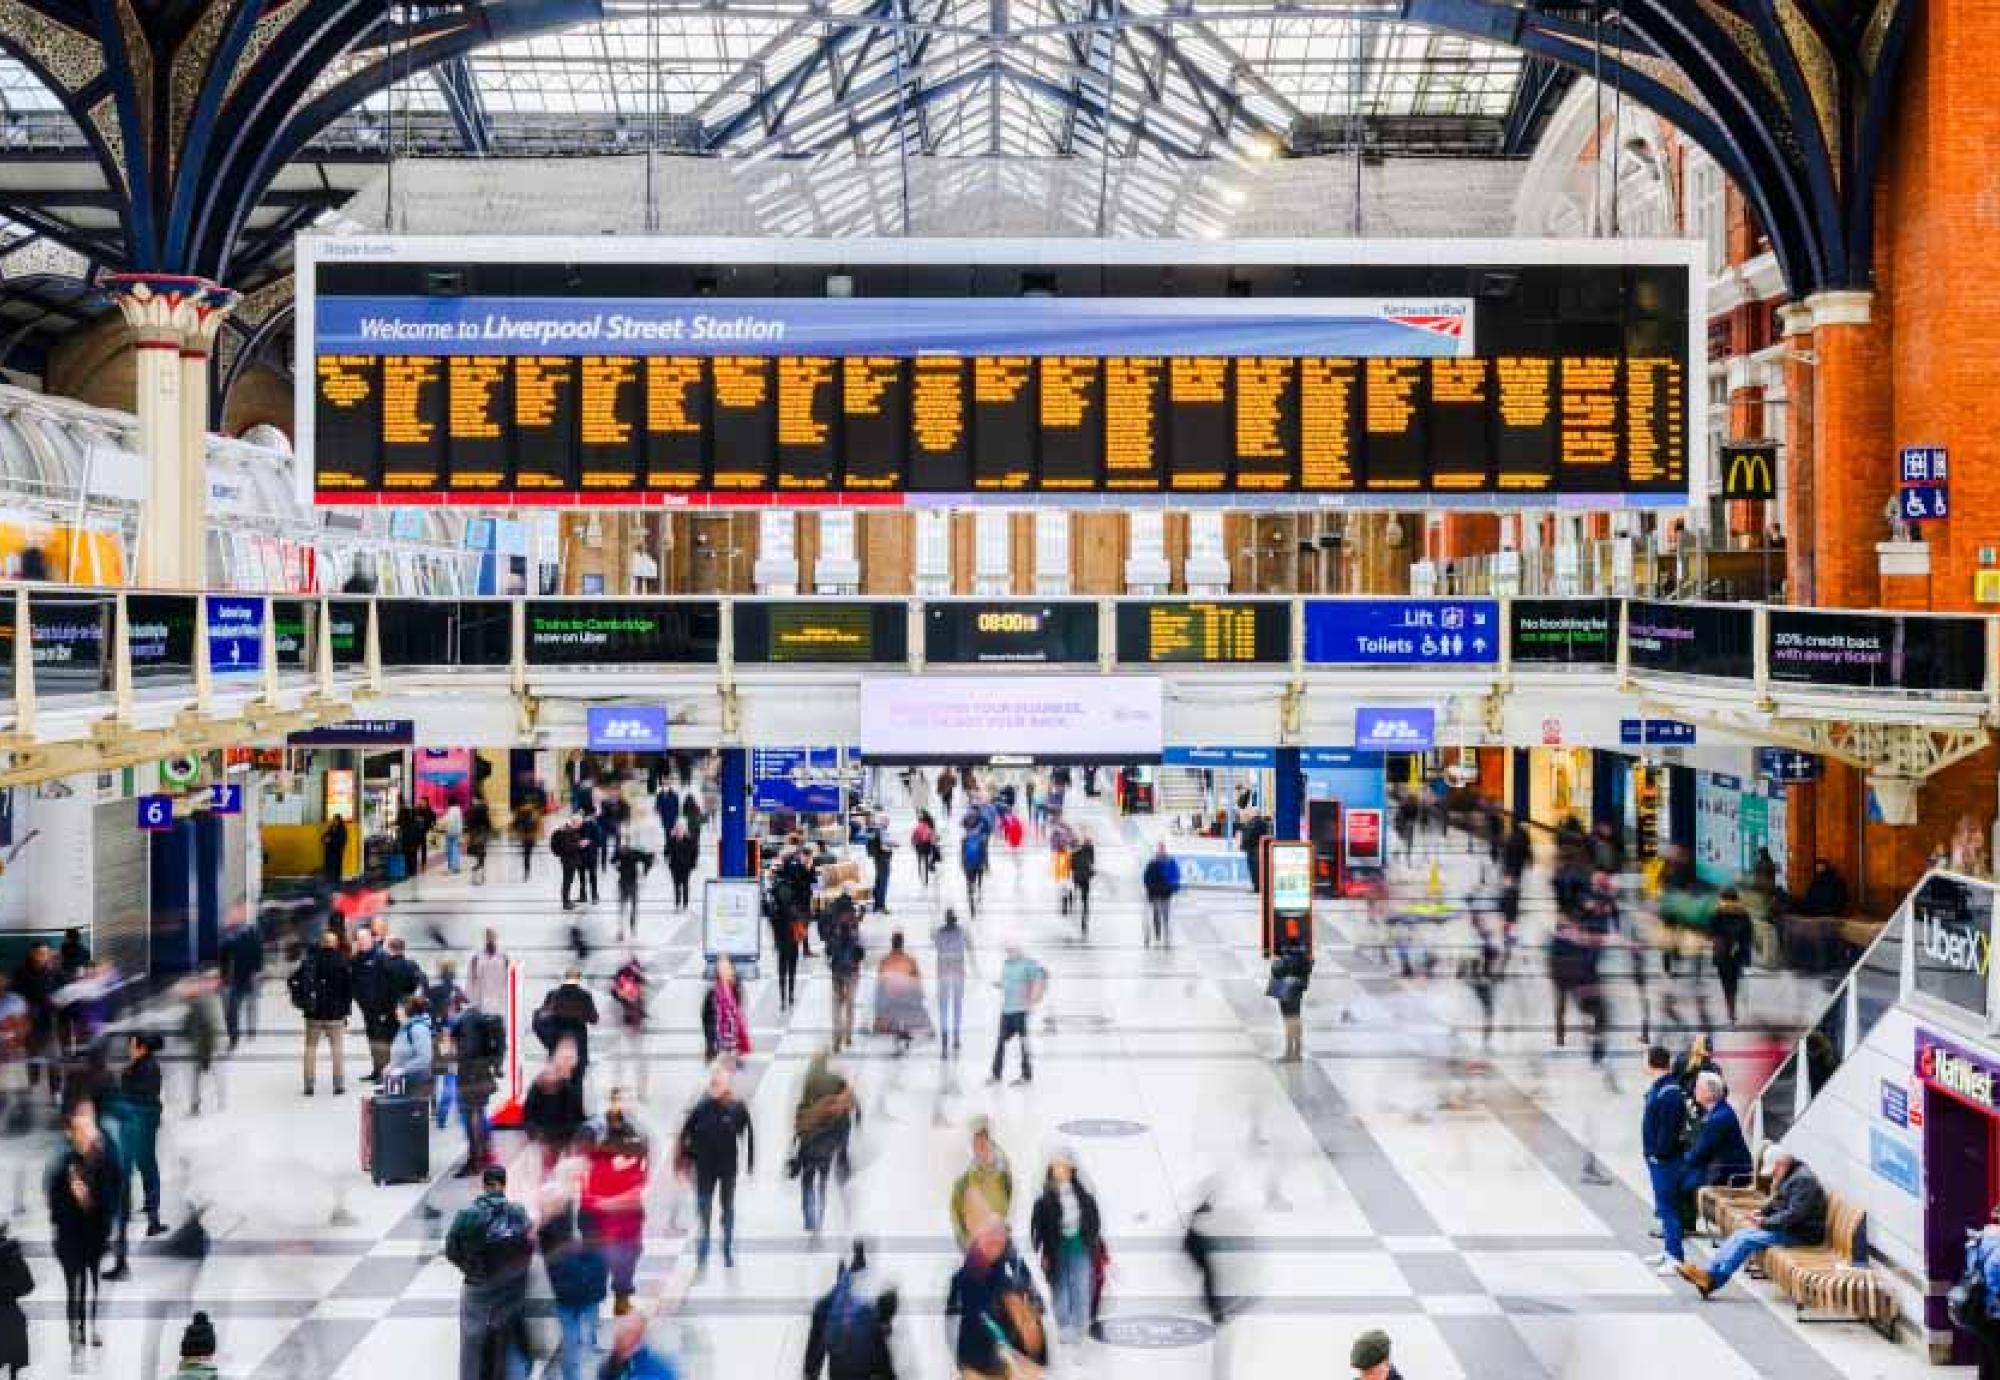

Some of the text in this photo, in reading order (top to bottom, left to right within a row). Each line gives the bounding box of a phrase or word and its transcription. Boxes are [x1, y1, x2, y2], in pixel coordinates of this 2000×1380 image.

[361, 313, 786, 346] Welcome to Liverpool Street Station
[534, 618, 655, 632] Trains to Cambridge
[1405, 609, 1433, 625] Lift
[1520, 618, 1538, 629] No
[1540, 617, 1591, 631] booking
[534, 631, 607, 643] now on Uber
[1357, 635, 1413, 653] Toilets
[1805, 634, 1846, 648] credit
[1847, 635, 1880, 649] back
[1776, 648, 1881, 665] with every ticket
[147, 803, 163, 823] 6
[1935, 1048, 1992, 1108] NatWest
